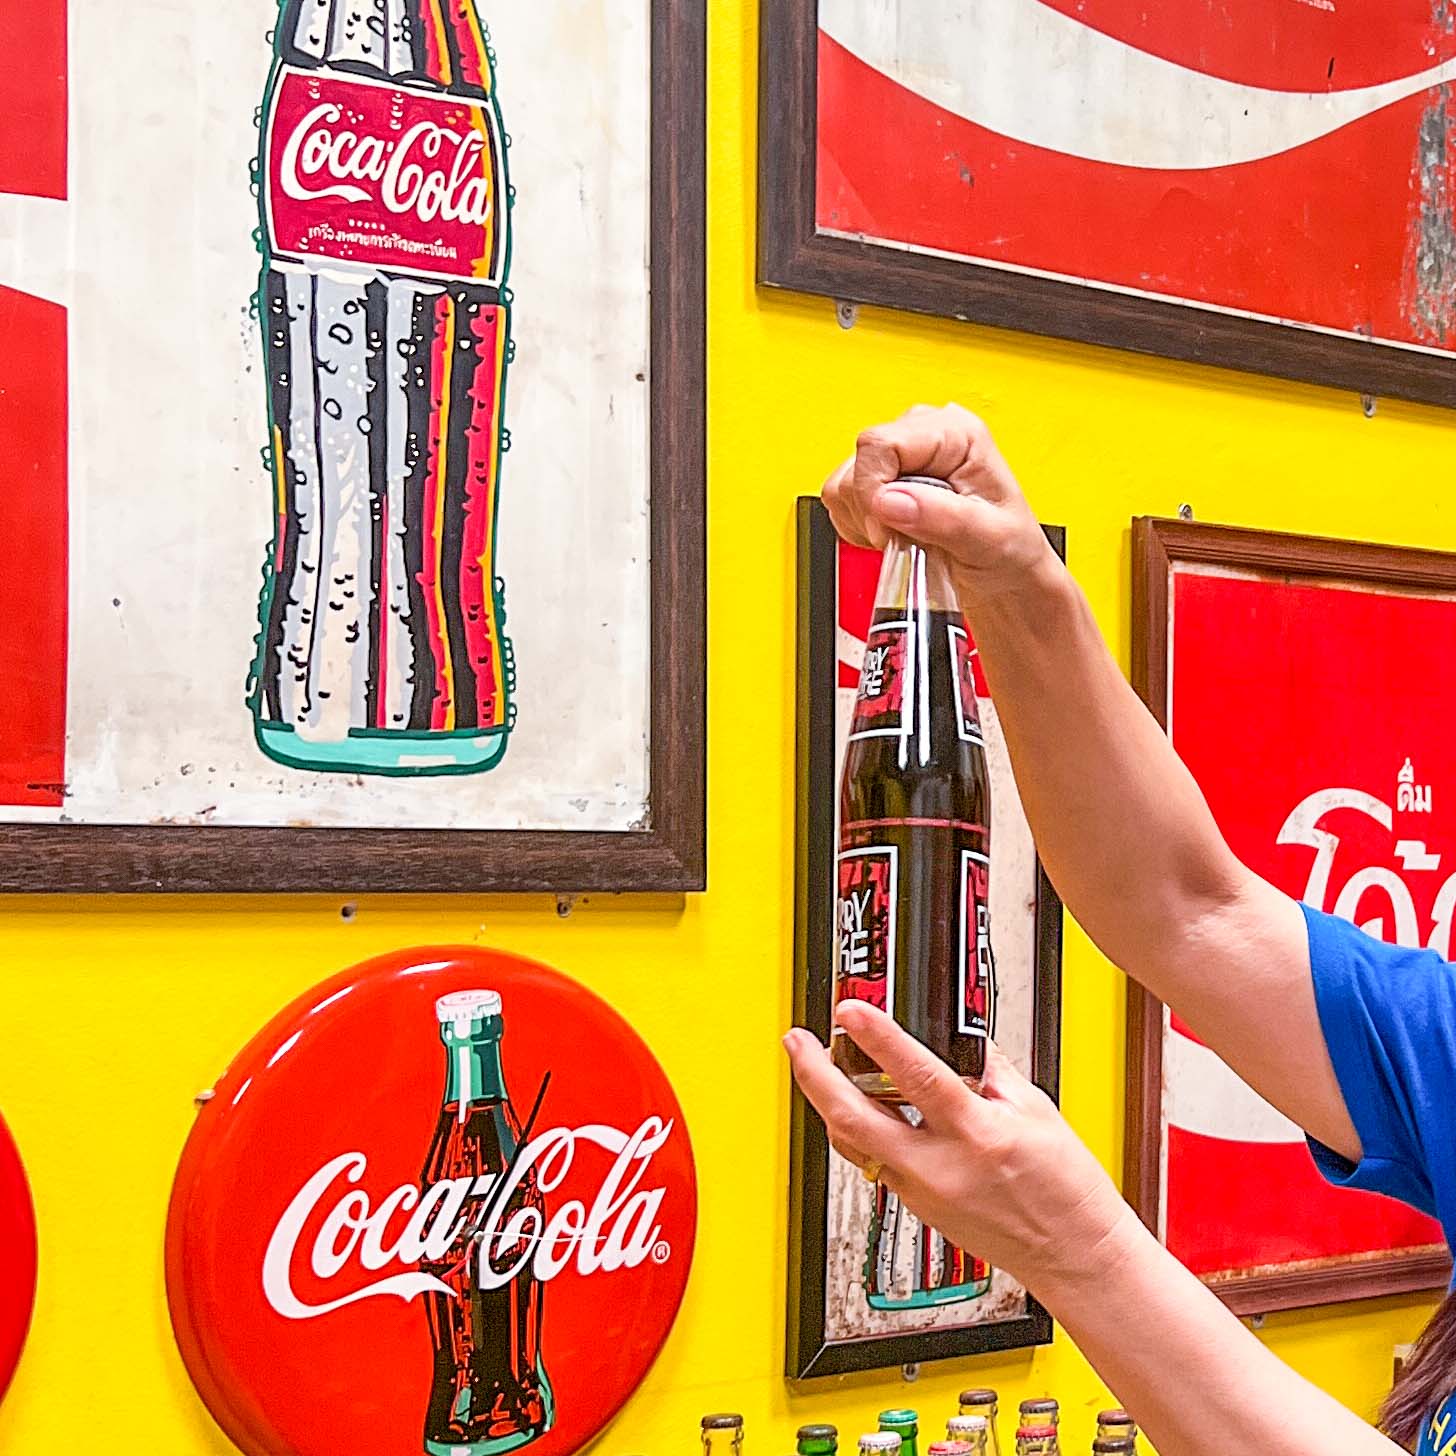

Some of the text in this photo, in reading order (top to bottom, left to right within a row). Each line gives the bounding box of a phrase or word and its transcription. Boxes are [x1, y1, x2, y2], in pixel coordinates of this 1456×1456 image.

[280, 103, 491, 225] Coca-Cola
[1395, 757, 1432, 813] ดื่ม
[262, 1115, 674, 1319] Coca-Cola
